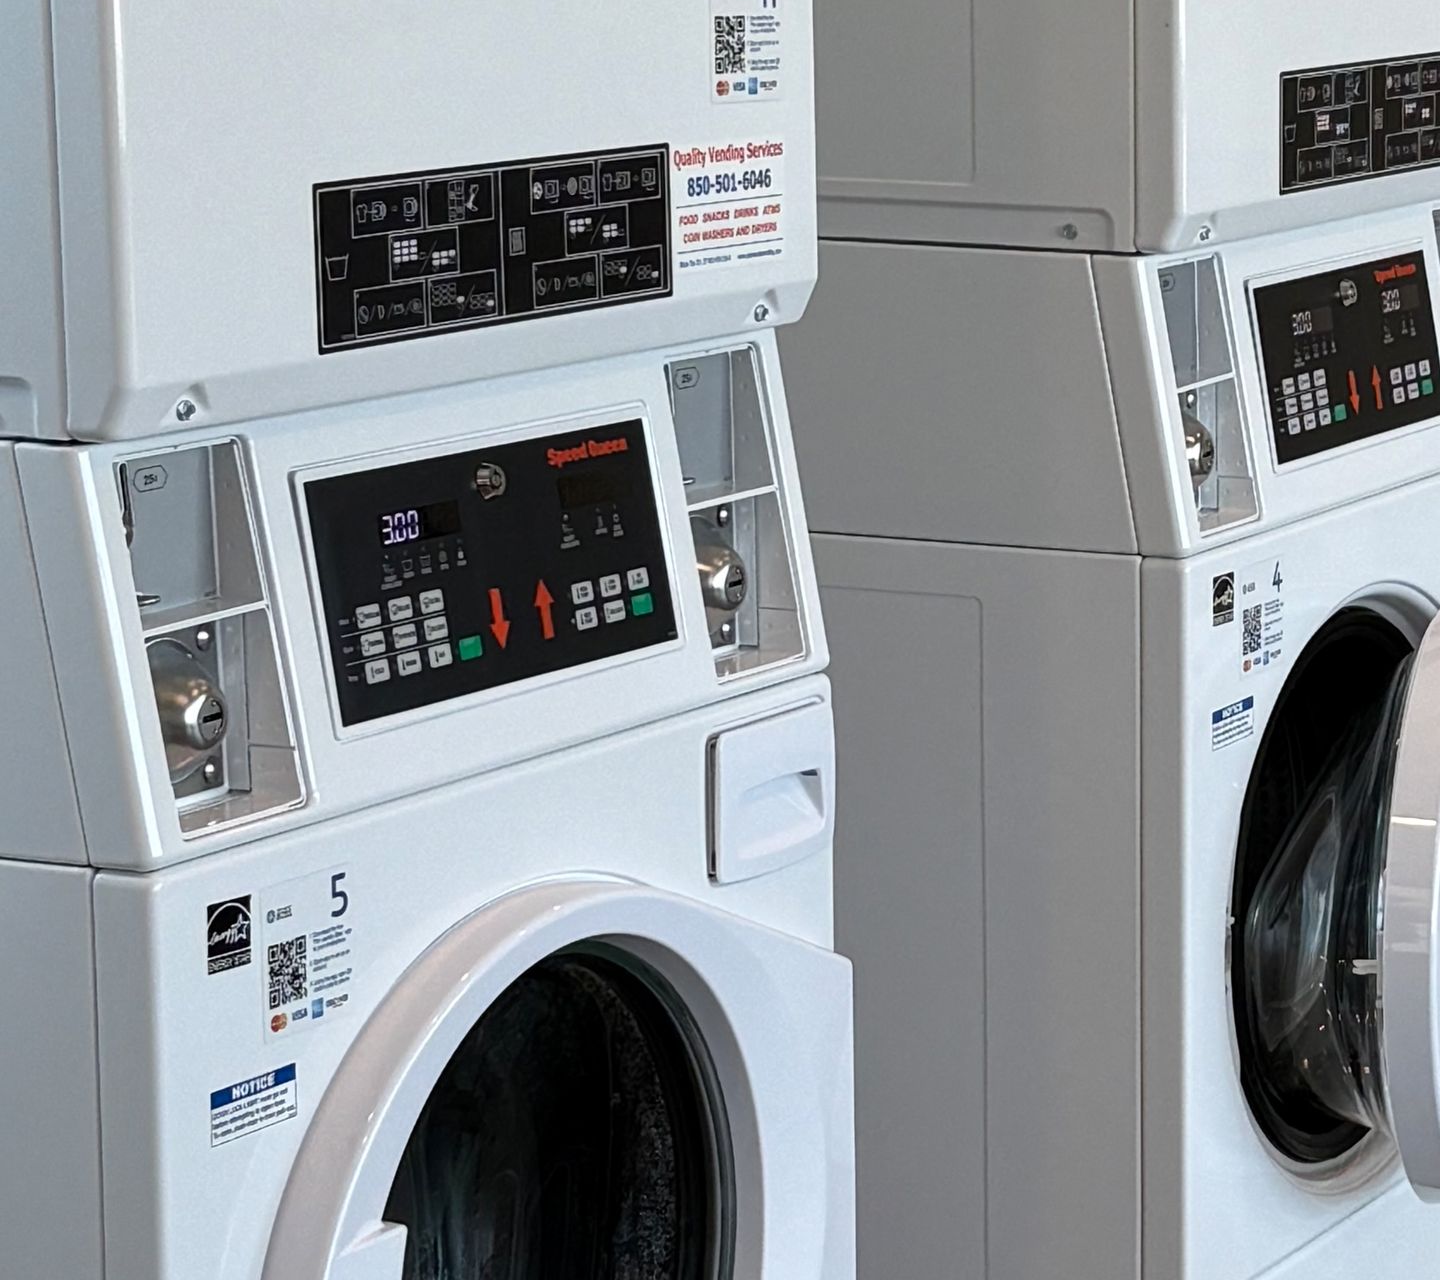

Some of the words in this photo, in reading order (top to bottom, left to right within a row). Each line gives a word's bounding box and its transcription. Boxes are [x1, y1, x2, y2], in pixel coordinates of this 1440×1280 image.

[673, 147, 706, 172] Quality
[708, 144, 745, 164] Vending
[746, 140, 783, 160] Services
[687, 168, 772, 197] 850-501-6046
[679, 214, 699, 227] FOOD
[547, 441, 589, 468] Speed
[382, 509, 420, 545] 3.00
[1272, 561, 1283, 593] 4
[331, 872, 349, 918] 5
[231, 1072, 276, 1100] NOTICE
